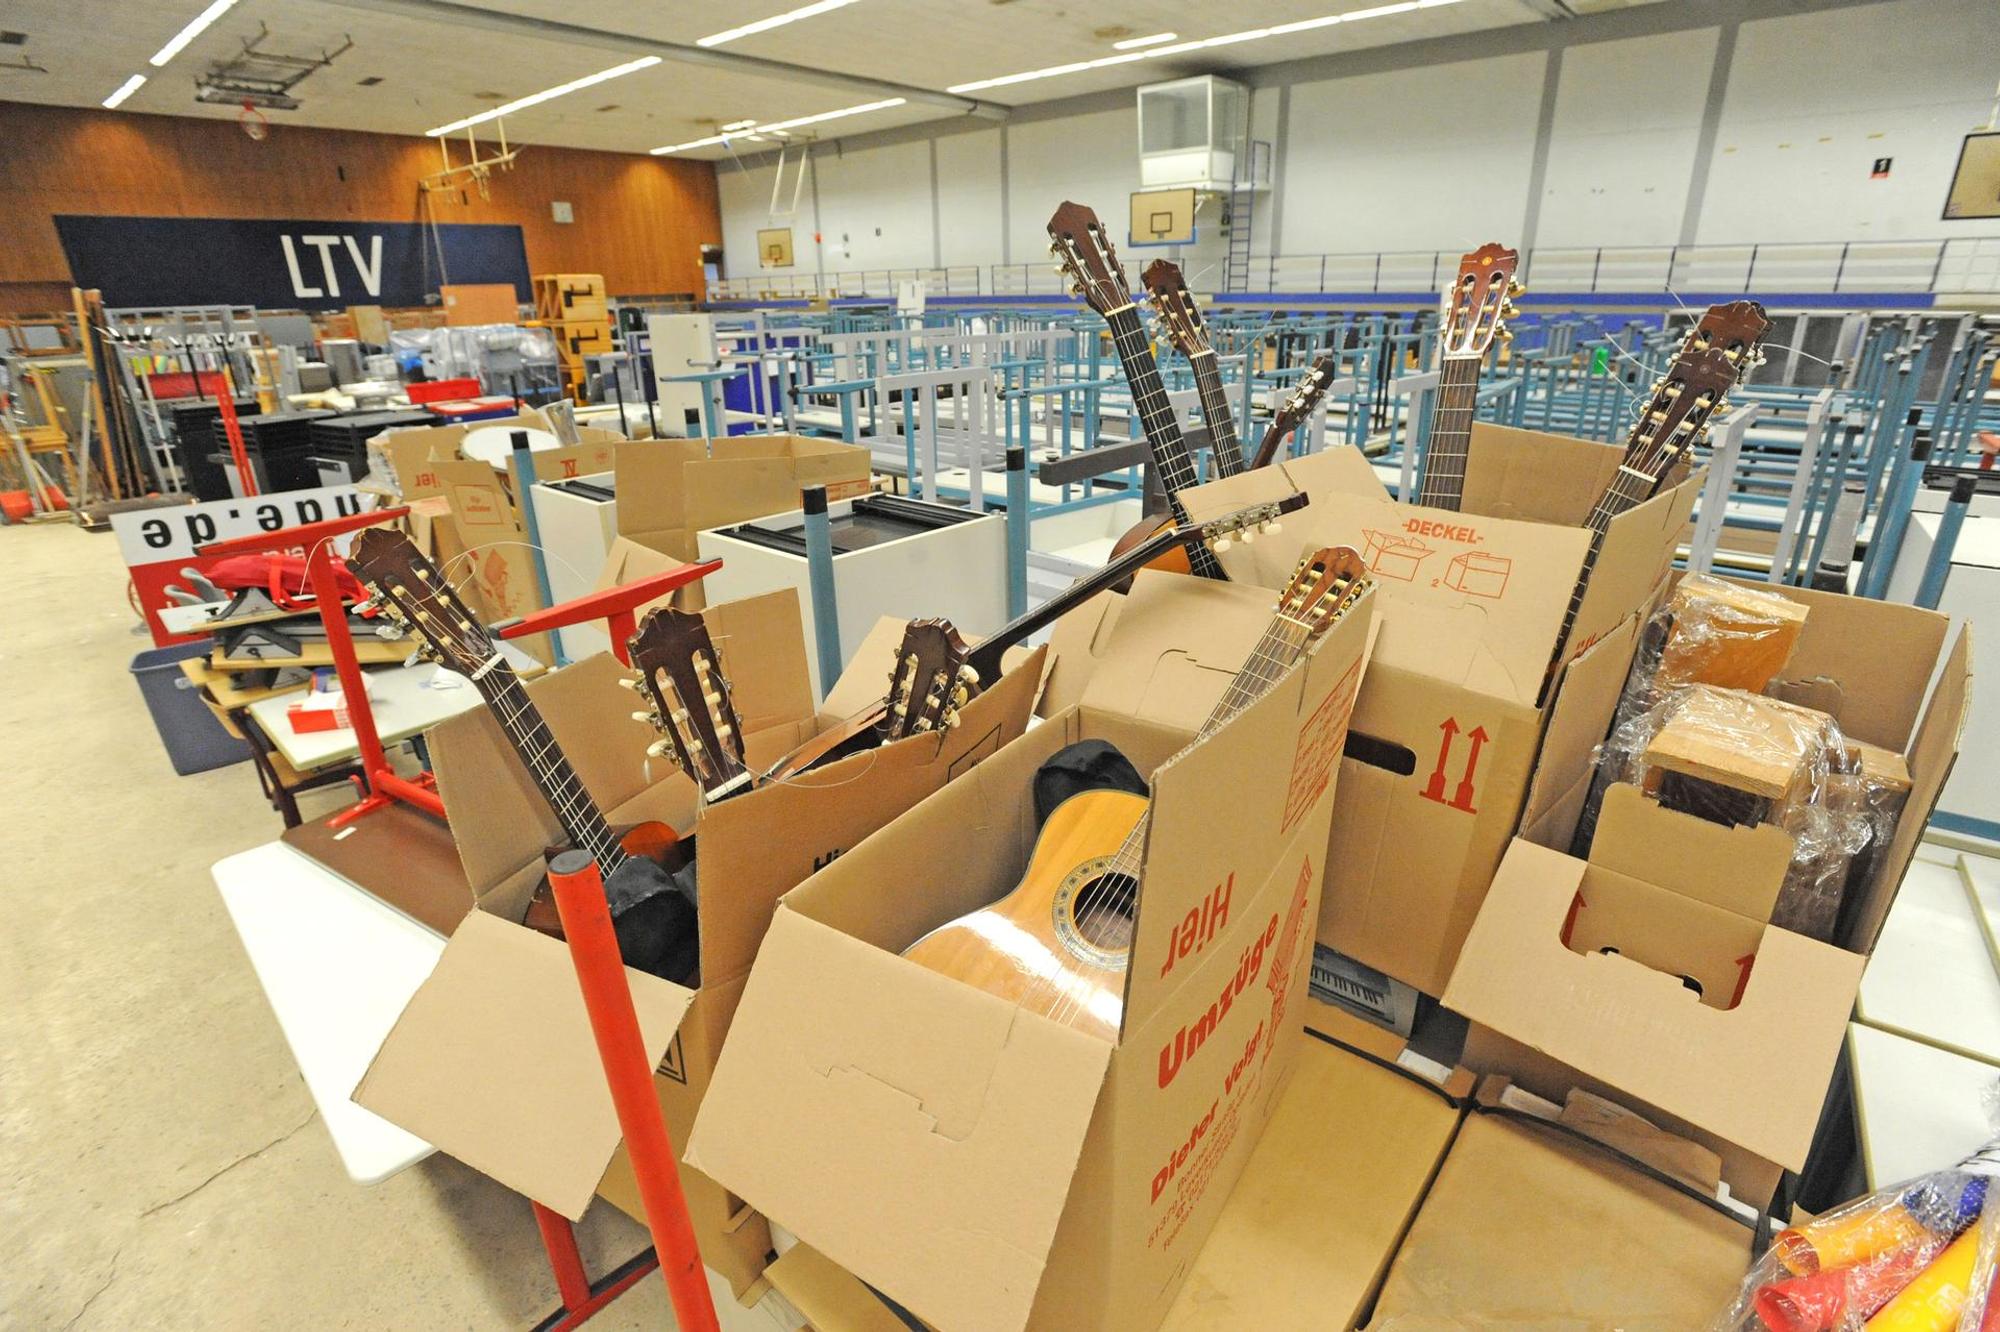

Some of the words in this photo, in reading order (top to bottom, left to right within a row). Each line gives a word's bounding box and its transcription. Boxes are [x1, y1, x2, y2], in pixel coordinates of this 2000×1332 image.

[280, 234, 383, 298] LTV
[141, 493, 362, 549] nde.de
[415, 471, 441, 489] ier
[1160, 871, 1235, 980] Hier
[1158, 912, 1279, 1089] Umzüge
[1151, 1098, 1219, 1206] Dieter
[1225, 1018, 1264, 1096] Voigt
